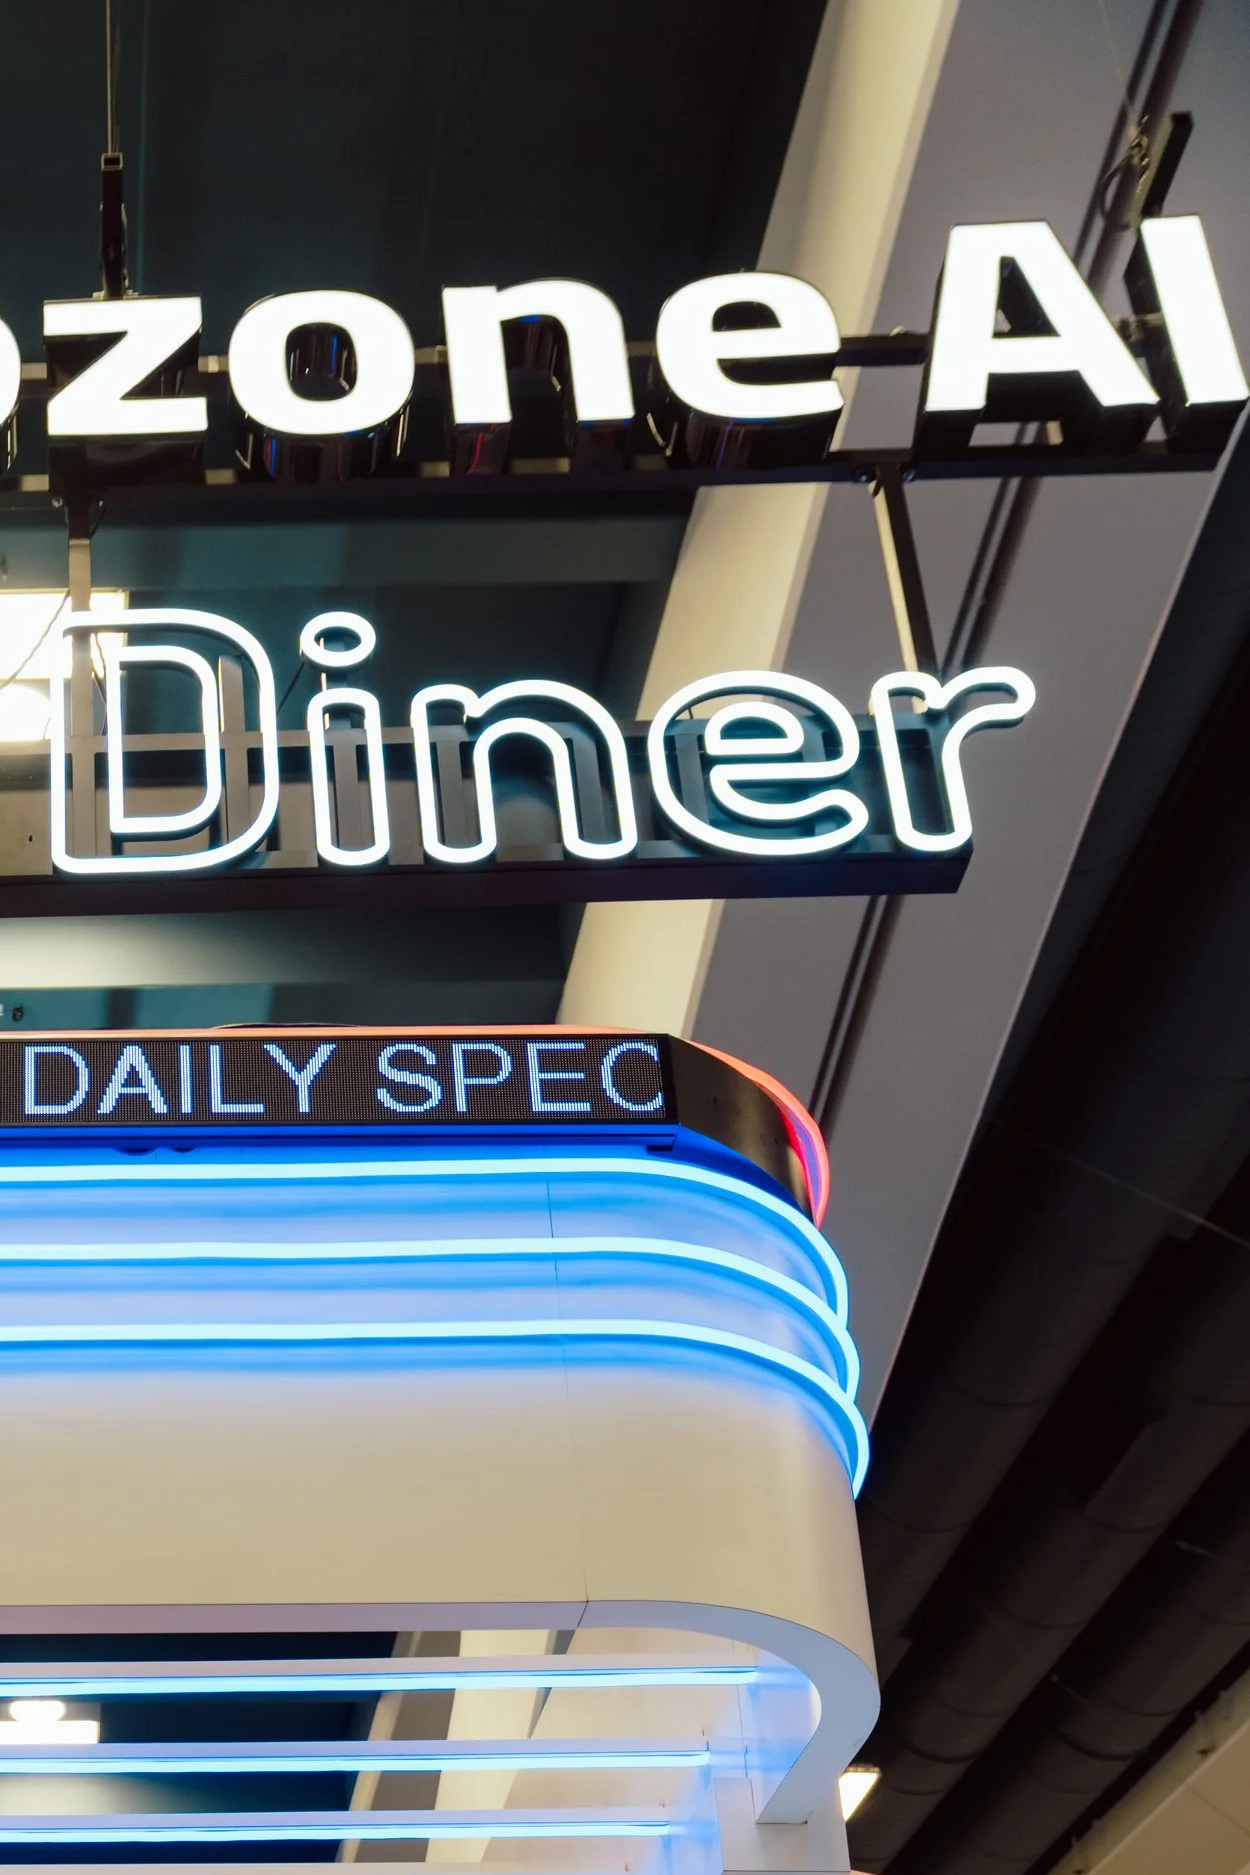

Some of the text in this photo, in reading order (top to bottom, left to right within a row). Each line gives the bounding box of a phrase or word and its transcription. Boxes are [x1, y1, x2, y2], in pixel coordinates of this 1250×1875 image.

[924, 216, 1248, 410] AI
[50, 608, 1036, 875] Diner
[21, 1043, 337, 1117] DAILY
[375, 1040, 665, 1115] SPEC
